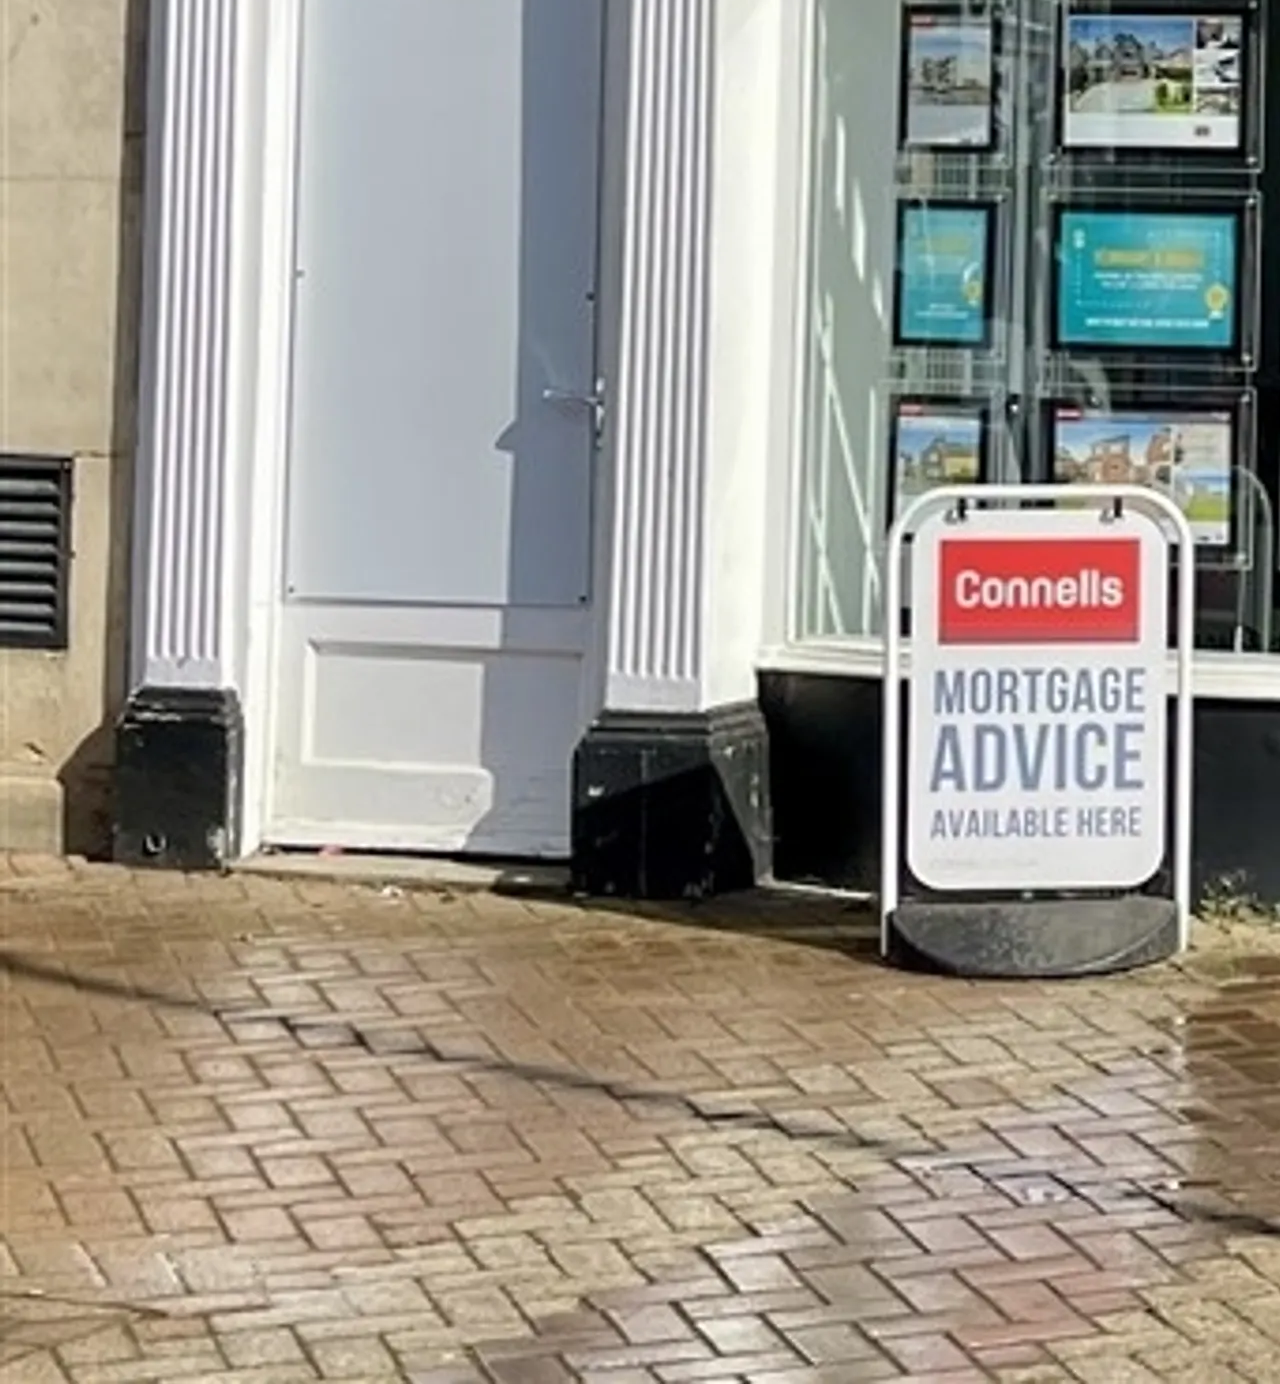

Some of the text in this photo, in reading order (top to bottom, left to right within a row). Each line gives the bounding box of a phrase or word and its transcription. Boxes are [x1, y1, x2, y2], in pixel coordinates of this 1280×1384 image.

[955, 569, 1125, 609] Connells
[933, 667, 1146, 714] MORTGAGE
[930, 723, 1145, 793] ADVICE
[930, 806, 1142, 838] AVAILABLE HERE
